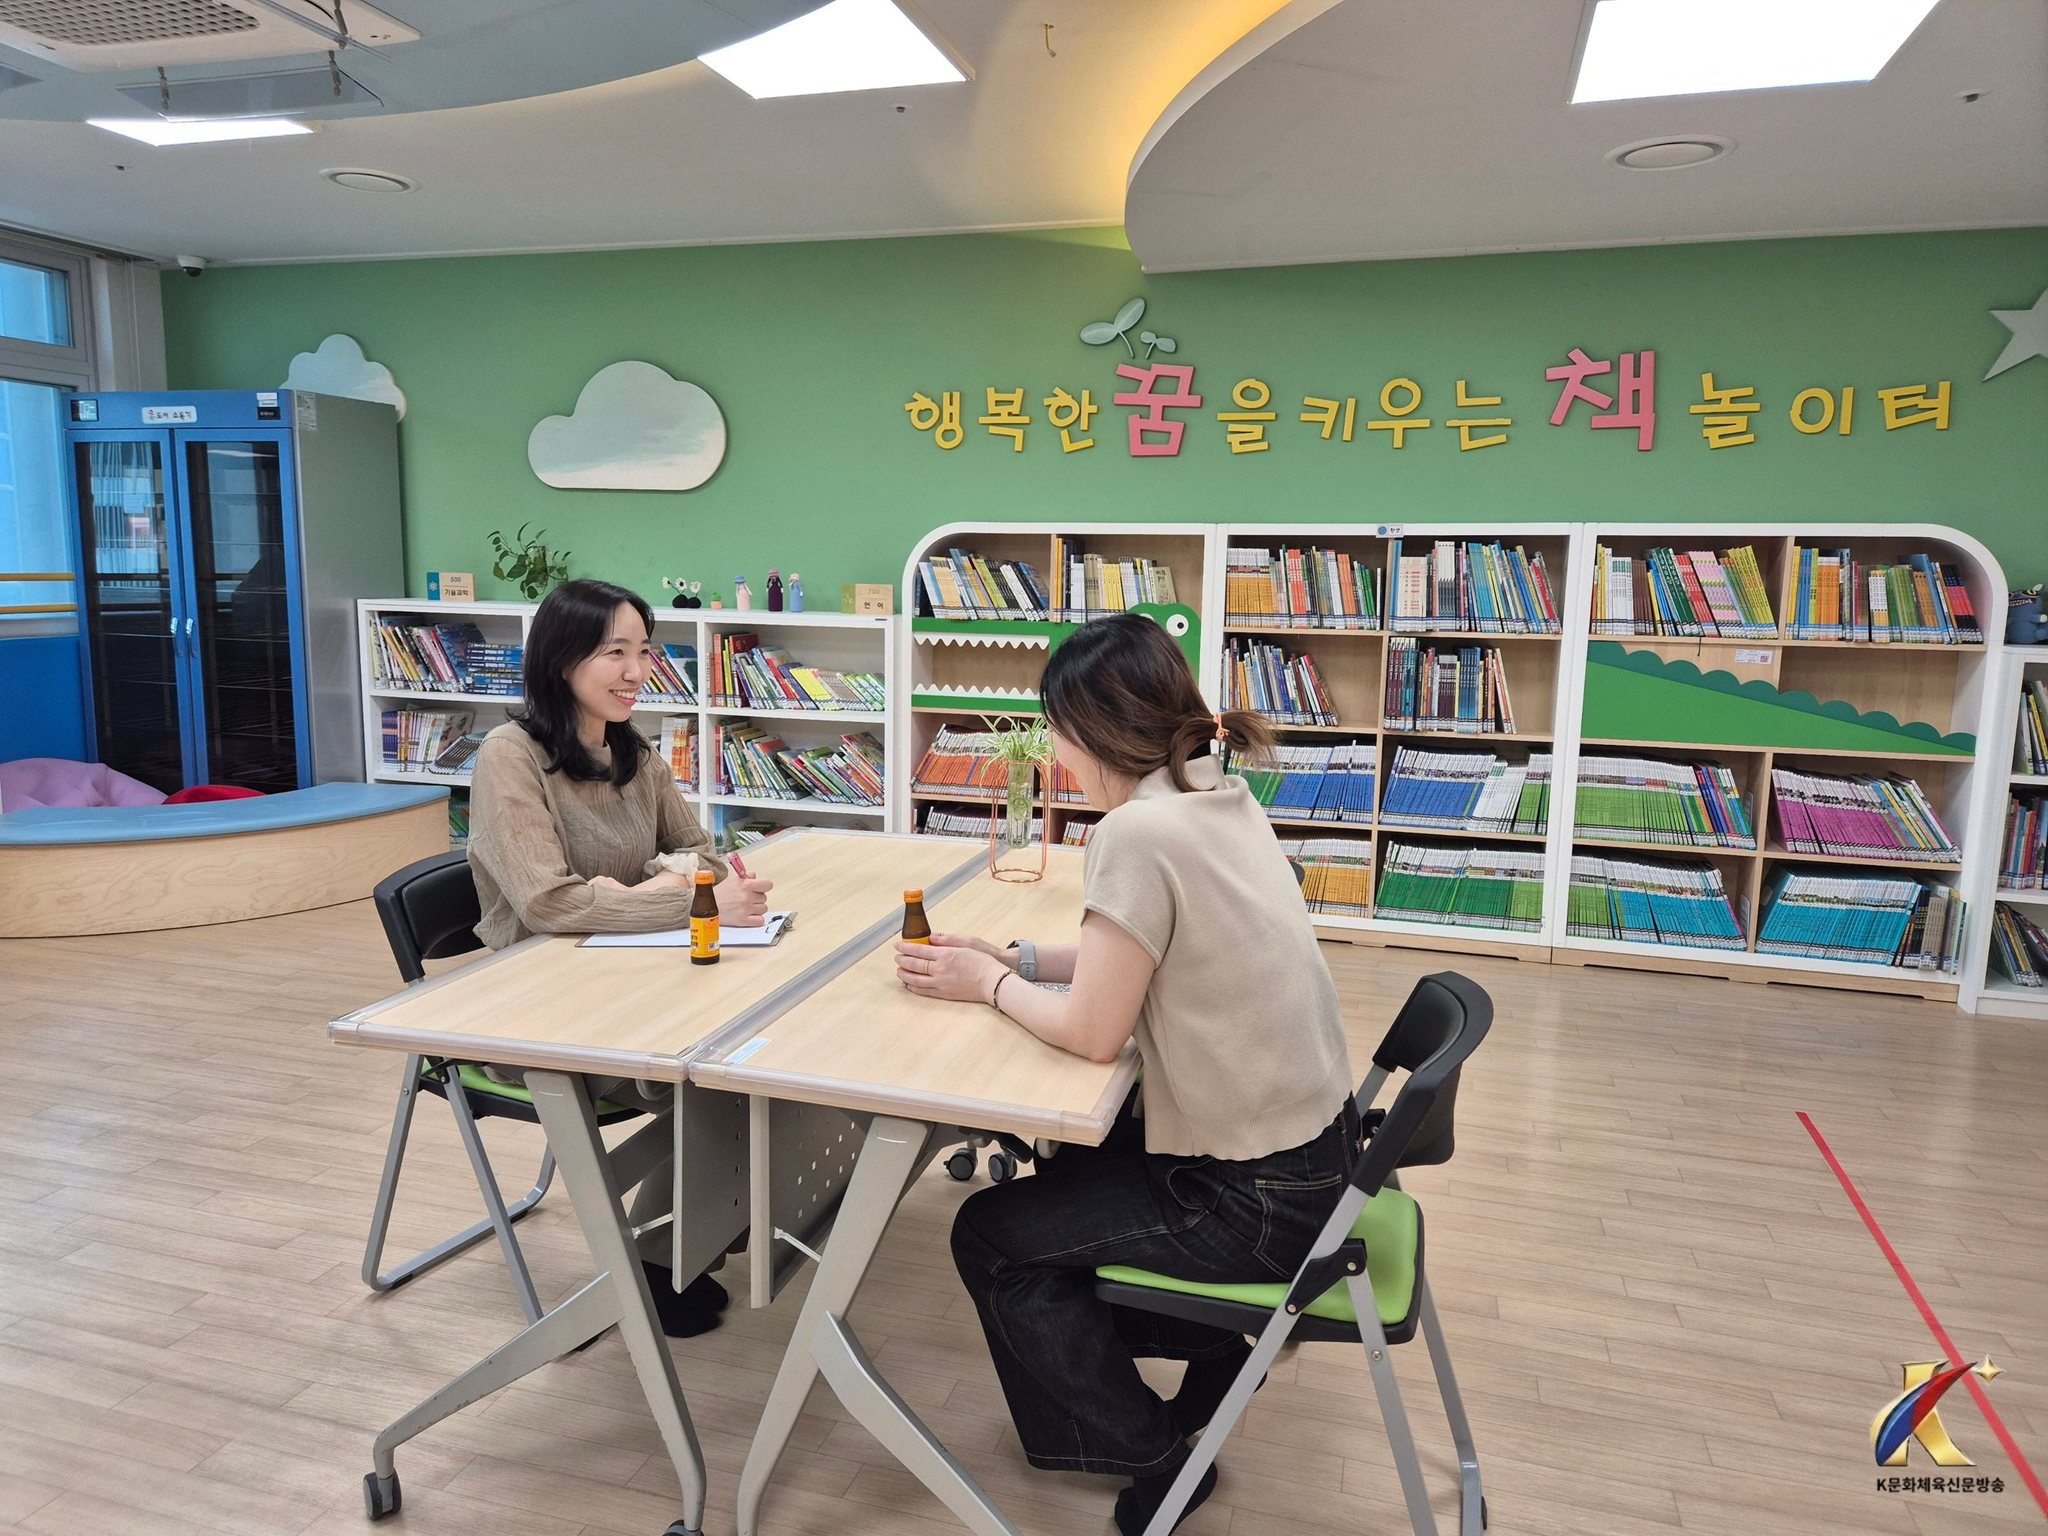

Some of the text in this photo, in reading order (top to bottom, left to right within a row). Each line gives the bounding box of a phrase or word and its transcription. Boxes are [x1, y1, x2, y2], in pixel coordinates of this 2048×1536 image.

[904, 386, 1099, 455] 행복한
[1113, 363, 1277, 456] 꿈을
[1299, 377, 1512, 451] 키우는
